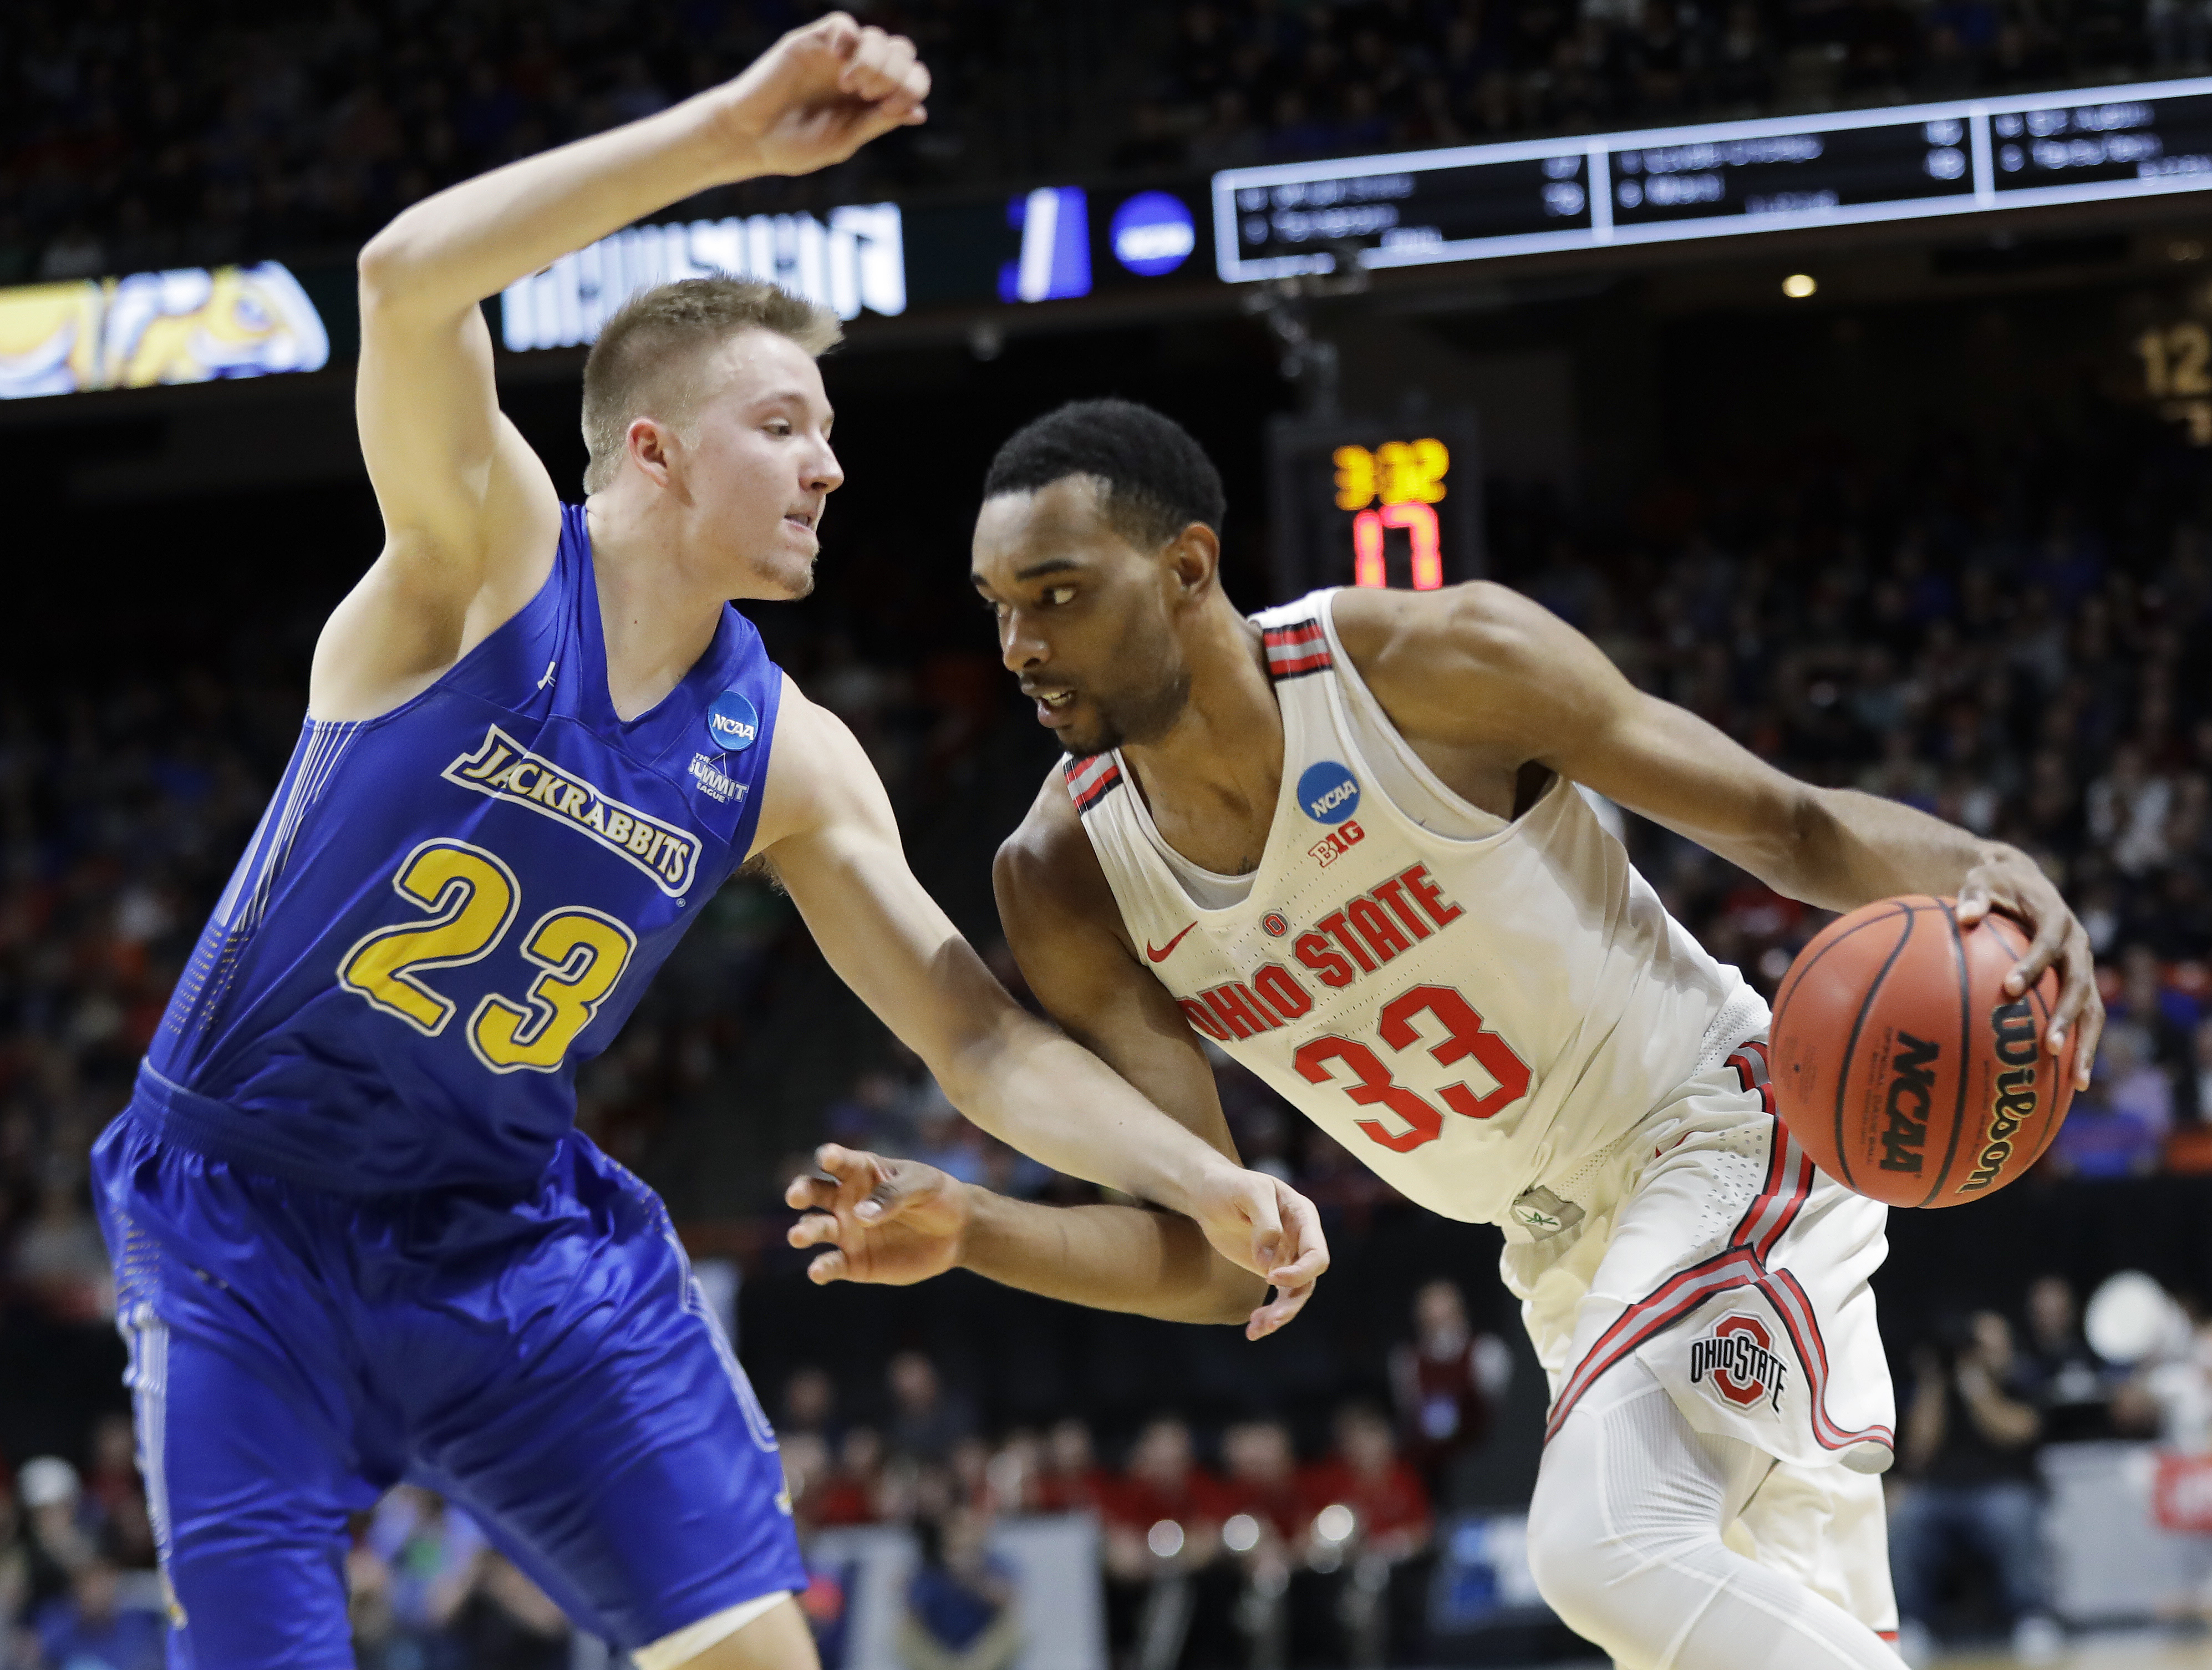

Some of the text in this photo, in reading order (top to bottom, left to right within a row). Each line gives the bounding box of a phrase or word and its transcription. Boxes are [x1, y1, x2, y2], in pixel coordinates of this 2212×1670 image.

[1353, 501, 1443, 590] 17
[688, 758, 749, 802] SUMMIT
[712, 713, 755, 740] NCAA
[462, 744, 690, 883] JACKRABBITS
[1310, 780, 1359, 818] NCAA
[336, 837, 638, 1074] 23
[1176, 860, 1467, 1043] OHIO STATE
[1292, 983, 1534, 1154] 33
[1880, 1031, 1940, 1172] NCAA
[1955, 994, 2038, 1194] Wilson
[1691, 1336, 1787, 1414] OHIO STATE
